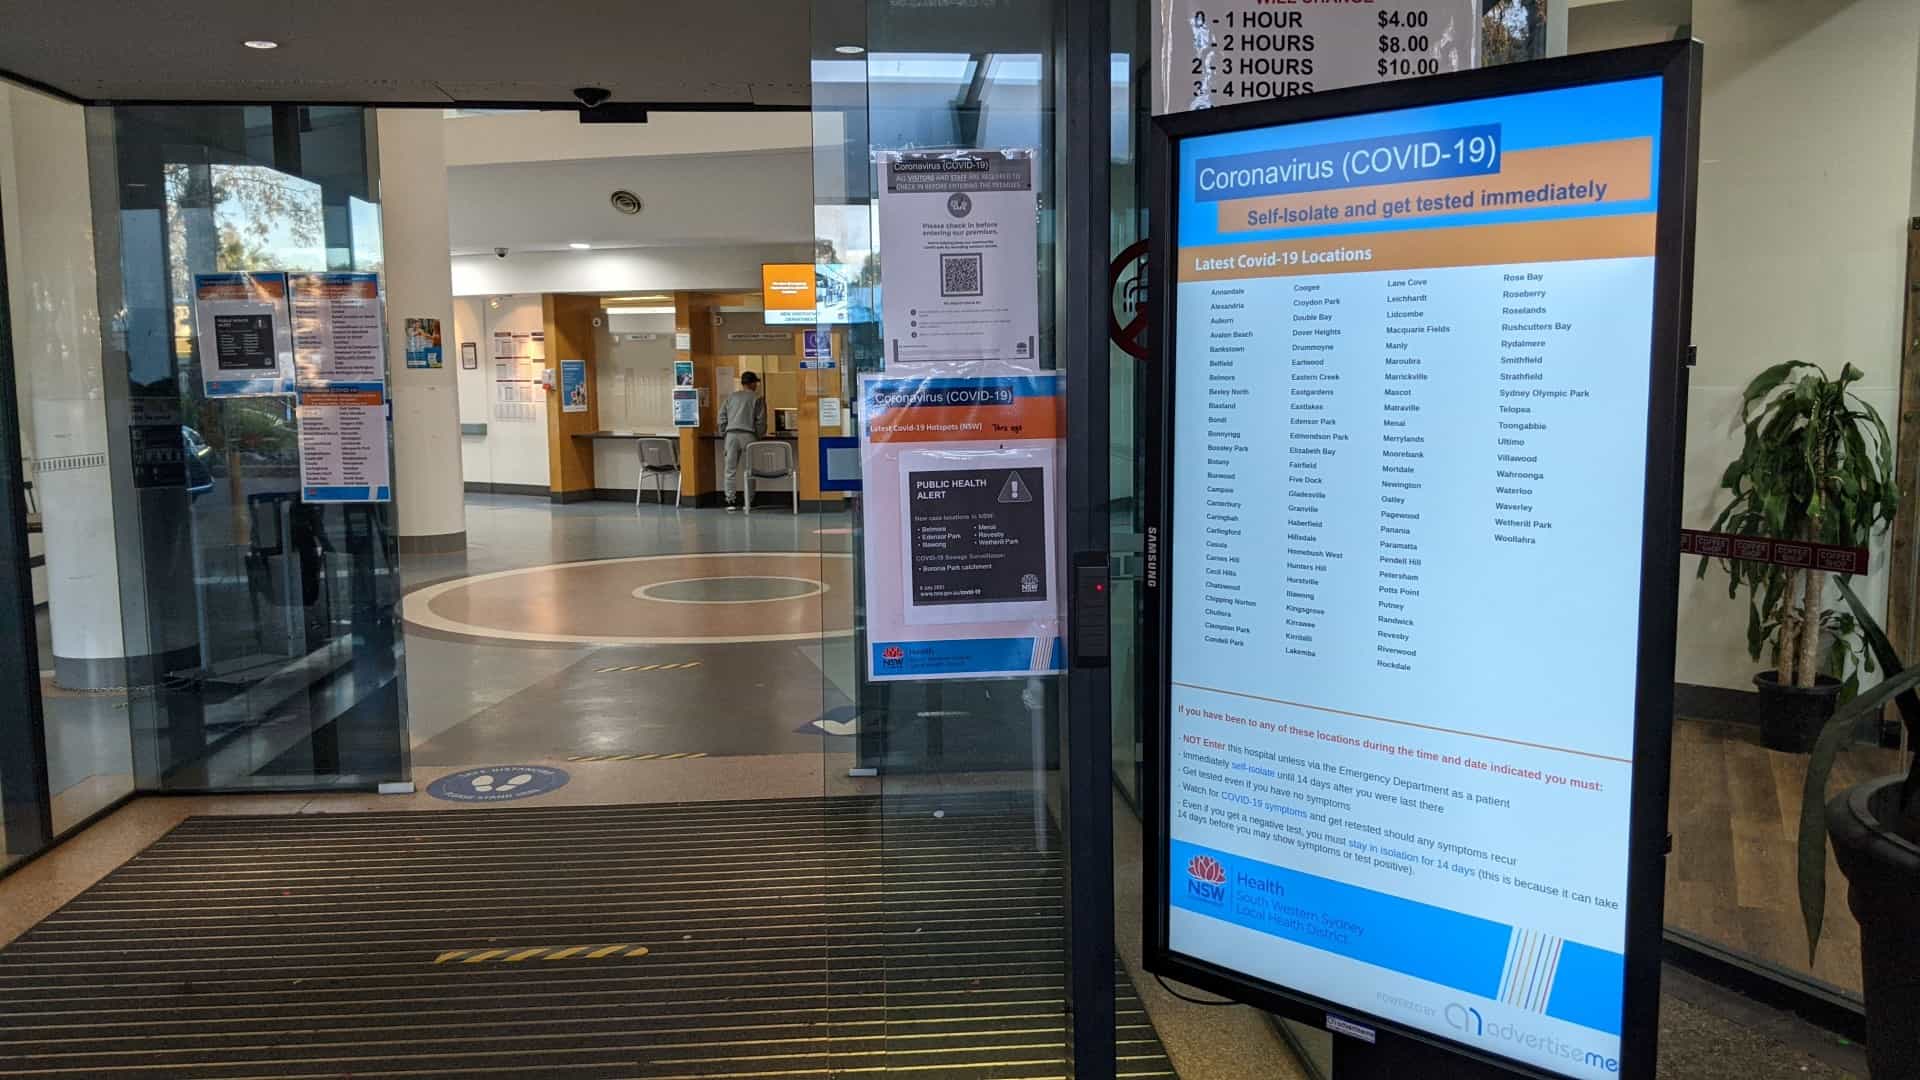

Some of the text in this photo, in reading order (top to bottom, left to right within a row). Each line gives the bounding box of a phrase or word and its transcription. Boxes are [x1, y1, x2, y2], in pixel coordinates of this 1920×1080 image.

[1226, 12, 1234, 28] 1
[1243, 11, 1303, 28] HOUR
[1378, 10, 1428, 29] $4.00
[1223, 35, 1234, 51] 2
[1241, 35, 1314, 52] HOURS
[1378, 35, 1429, 53] $8.00
[1191, 59, 1203, 75] 2
[1222, 59, 1233, 75] 3
[1240, 58, 1313, 75] HOURS
[1377, 58, 1439, 77] $10.00
[1223, 81, 1234, 97] 4
[1241, 81, 1314, 98] HOURS
[942, 160, 989, 171] (COVID-19)
[1200, 135, 1496, 192] Coronavirus (COVID-19)
[1247, 180, 1607, 226] Self-Isolate and get tested immediately
[1195, 247, 1372, 272] Latest Covid-19 Locations
[1504, 273, 1544, 282] Rose Bay
[1387, 294, 1427, 303] Leichhardt
[1502, 290, 1546, 298] Roseberry
[1502, 306, 1547, 315] Roselands
[1314, 328, 1341, 336] Heights
[1386, 326, 1425, 336] Macquarie
[1555, 322, 1572, 332] Bay
[1386, 342, 1408, 351] Manly
[1501, 340, 1546, 349] Rydalmere
[1500, 356, 1543, 364] Smithfield
[875, 390, 1012, 404] Coronavirus (COVID-19)
[1500, 389, 1530, 398] Sydney
[1532, 389, 1567, 398] Olympic
[1499, 405, 1531, 414] Telopea
[893, 423, 925, 432] Covid-19
[927, 423, 958, 433] Hotspots
[960, 423, 982, 431] (NSW)
[1499, 422, 1547, 431] Toongabbie
[1498, 438, 1525, 446] Ultimo
[1497, 454, 1537, 462] Villawood
[1496, 470, 1544, 480] Wahroonga
[917, 479, 987, 489] PUBLIC HEALTH
[917, 491, 946, 500] ALERT
[1496, 486, 1533, 495] Waterloo
[1496, 502, 1533, 512] Waverley
[1494, 518, 1531, 527] Wetherill
[1494, 534, 1536, 544] Woollahra
[1148, 527, 1157, 587] SAMSUNG
[1178, 704, 1183, 712] If
[1185, 708, 1200, 716] you
[1202, 708, 1223, 720] have
[1225, 713, 1246, 725] been
[1259, 721, 1275, 732] any
[1278, 723, 1287, 732] of
[1289, 726, 1314, 738] these
[1316, 730, 1360, 746] locations
[1363, 739, 1394, 755] during
[1397, 744, 1414, 756] the
[1416, 748, 1438, 760] time
[1441, 754, 1461, 765] and
[1464, 757, 1487, 770] date
[1490, 762, 1541, 780] indicated
[1544, 774, 1566, 784] you
[1570, 779, 1603, 791] must:
[1183, 734, 1201, 744] NOT
[1203, 738, 1225, 749] Enter
[1227, 743, 1242, 754] this
[1244, 746, 1275, 760] hospital
[1278, 755, 1305, 766] unless
[1307, 760, 1320, 769] via
[1322, 762, 1336, 773] the
[1338, 765, 1390, 785] Emergency
[1393, 776, 1448, 795] Department
[1451, 790, 1464, 799] as
[1475, 794, 1510, 808] patient
[1182, 781, 1518, 866] Watch for COVID-19 symptoms and get retested should any symptoms recur
[1237, 872, 1284, 897] Health
[1188, 881, 1225, 901] NSW
[1237, 892, 1365, 937] South Western Sydney
[1236, 904, 1350, 945] Local Health District
